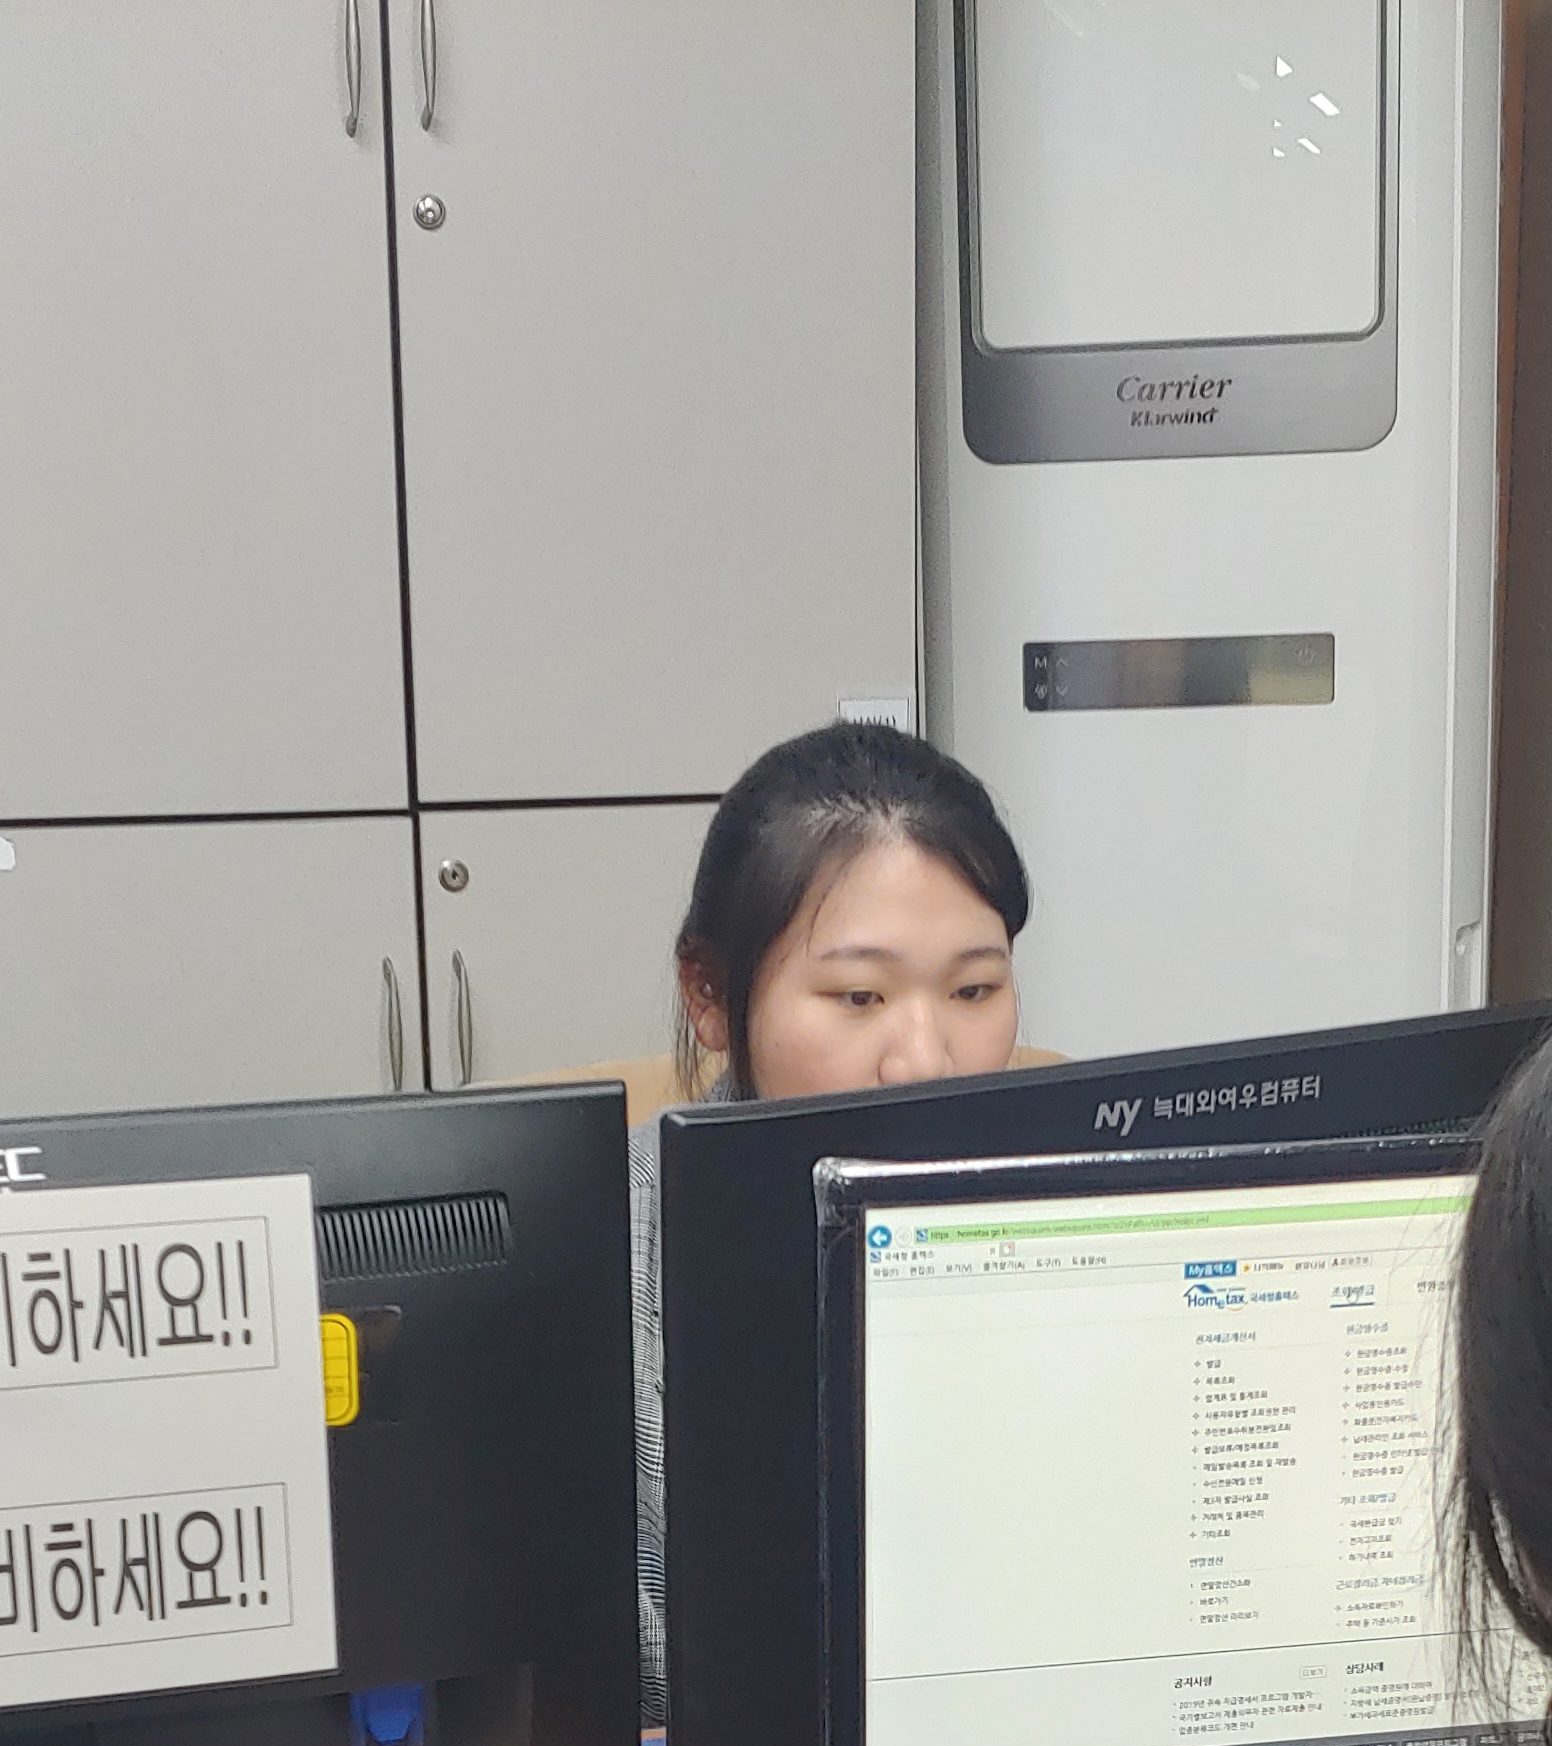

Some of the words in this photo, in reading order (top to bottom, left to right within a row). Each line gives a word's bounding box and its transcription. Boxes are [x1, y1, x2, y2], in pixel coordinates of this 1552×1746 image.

[1116, 374, 1233, 402] Carrier
[1153, 1074, 1321, 1120] 늑대와여우컴퓨터
[1188, 1262, 1234, 1277] My홈택스
[1345, 1661, 1384, 1674] 상담사례
[1173, 1675, 1213, 1689] 공지사항
